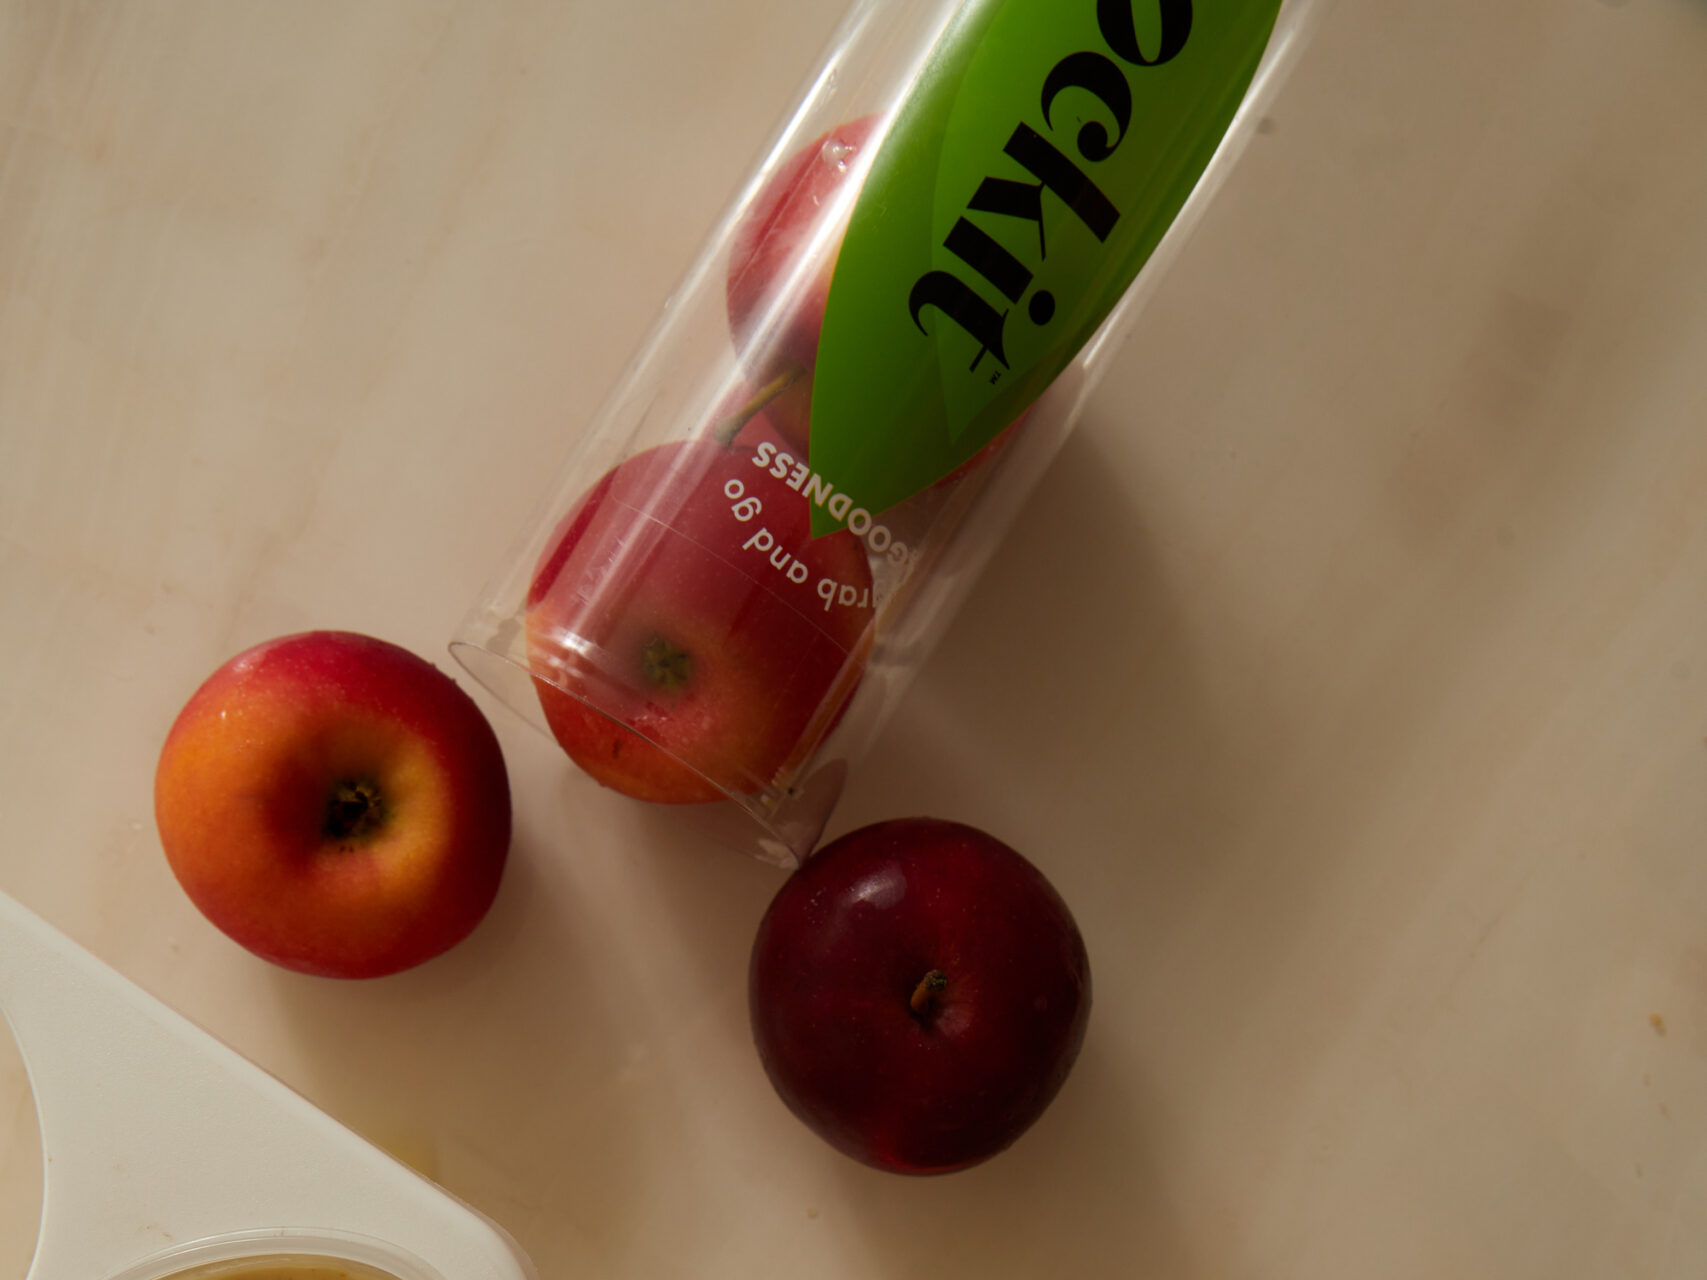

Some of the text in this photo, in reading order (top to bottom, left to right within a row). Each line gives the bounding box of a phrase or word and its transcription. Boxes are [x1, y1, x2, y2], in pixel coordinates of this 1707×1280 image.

[724, 479, 762, 521] go
[752, 442, 908, 565] GOODNESS
[742, 528, 809, 584] and
